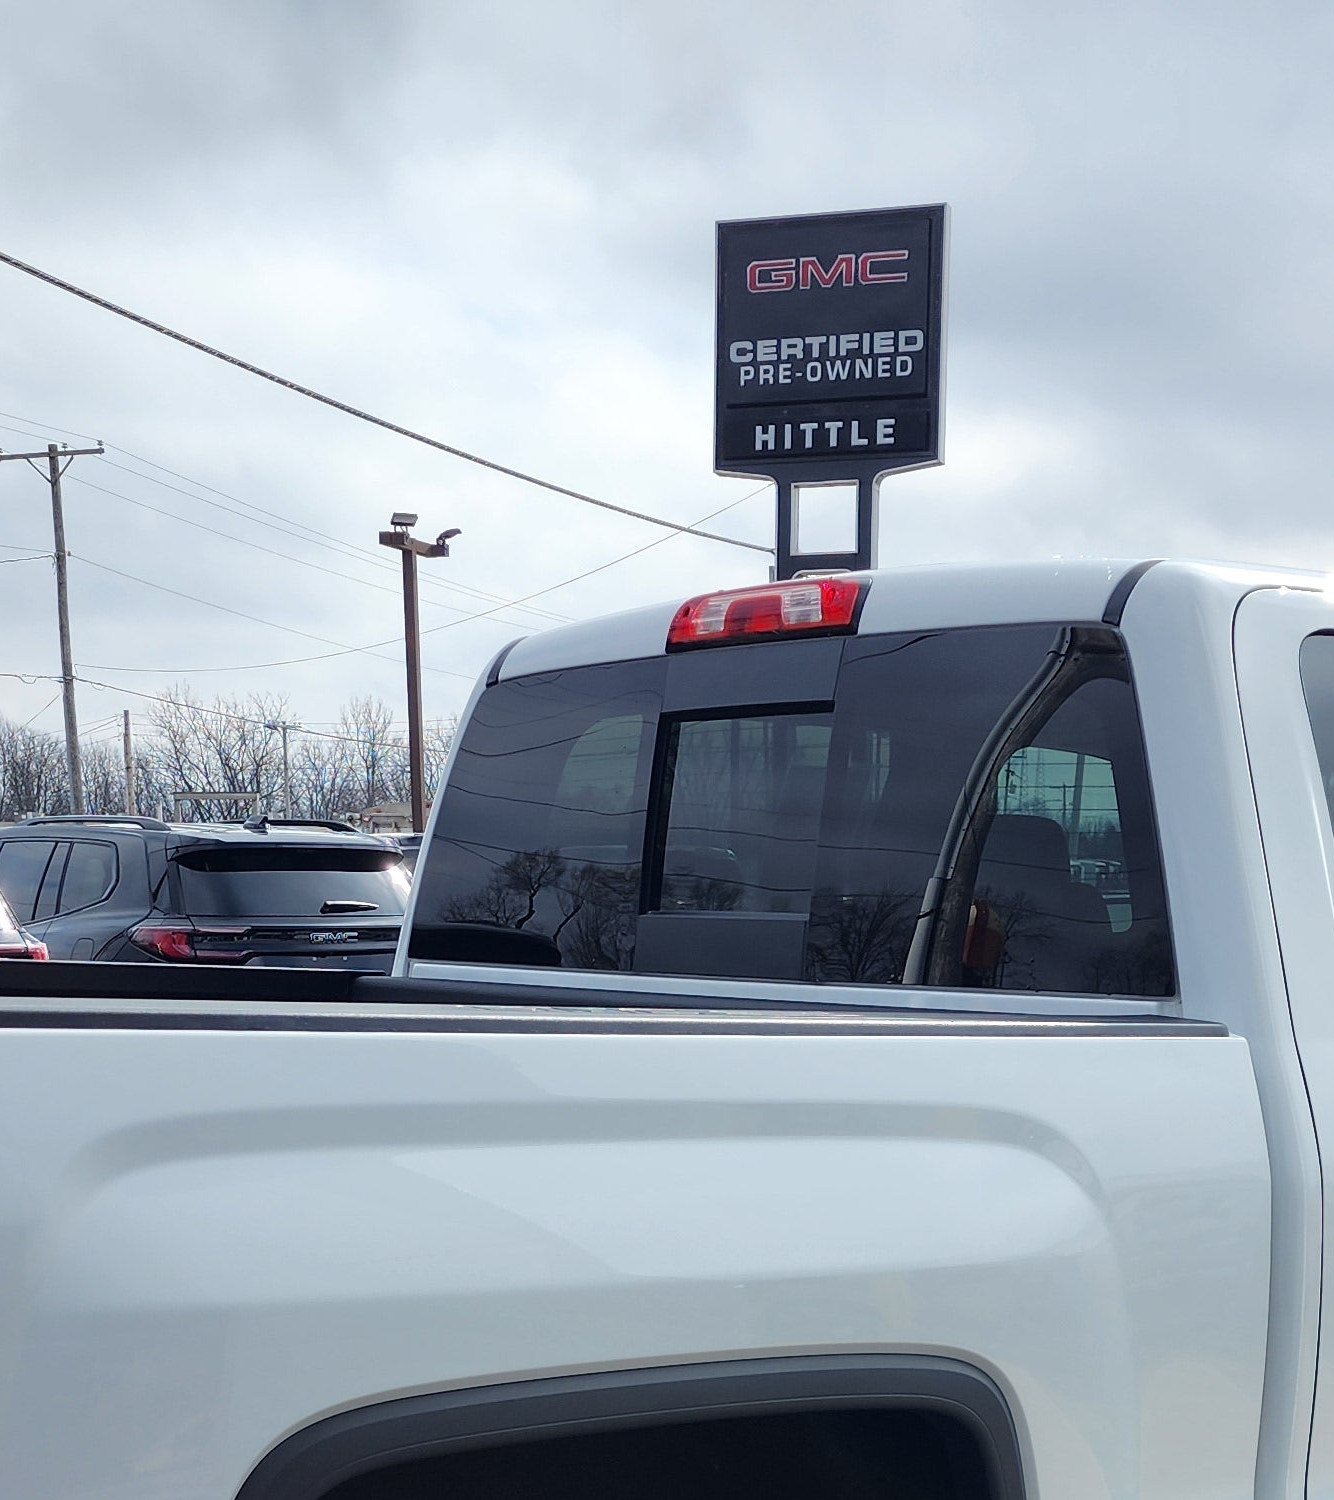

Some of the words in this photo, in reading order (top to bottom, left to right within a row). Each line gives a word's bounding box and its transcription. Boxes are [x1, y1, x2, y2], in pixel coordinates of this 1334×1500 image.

[747, 250, 909, 293] GMC
[729, 329, 924, 363] CERTIFIED
[739, 355, 913, 386] PRE-OWNED
[755, 418, 896, 451] HITTLE
[310, 932, 358, 944] GMC
